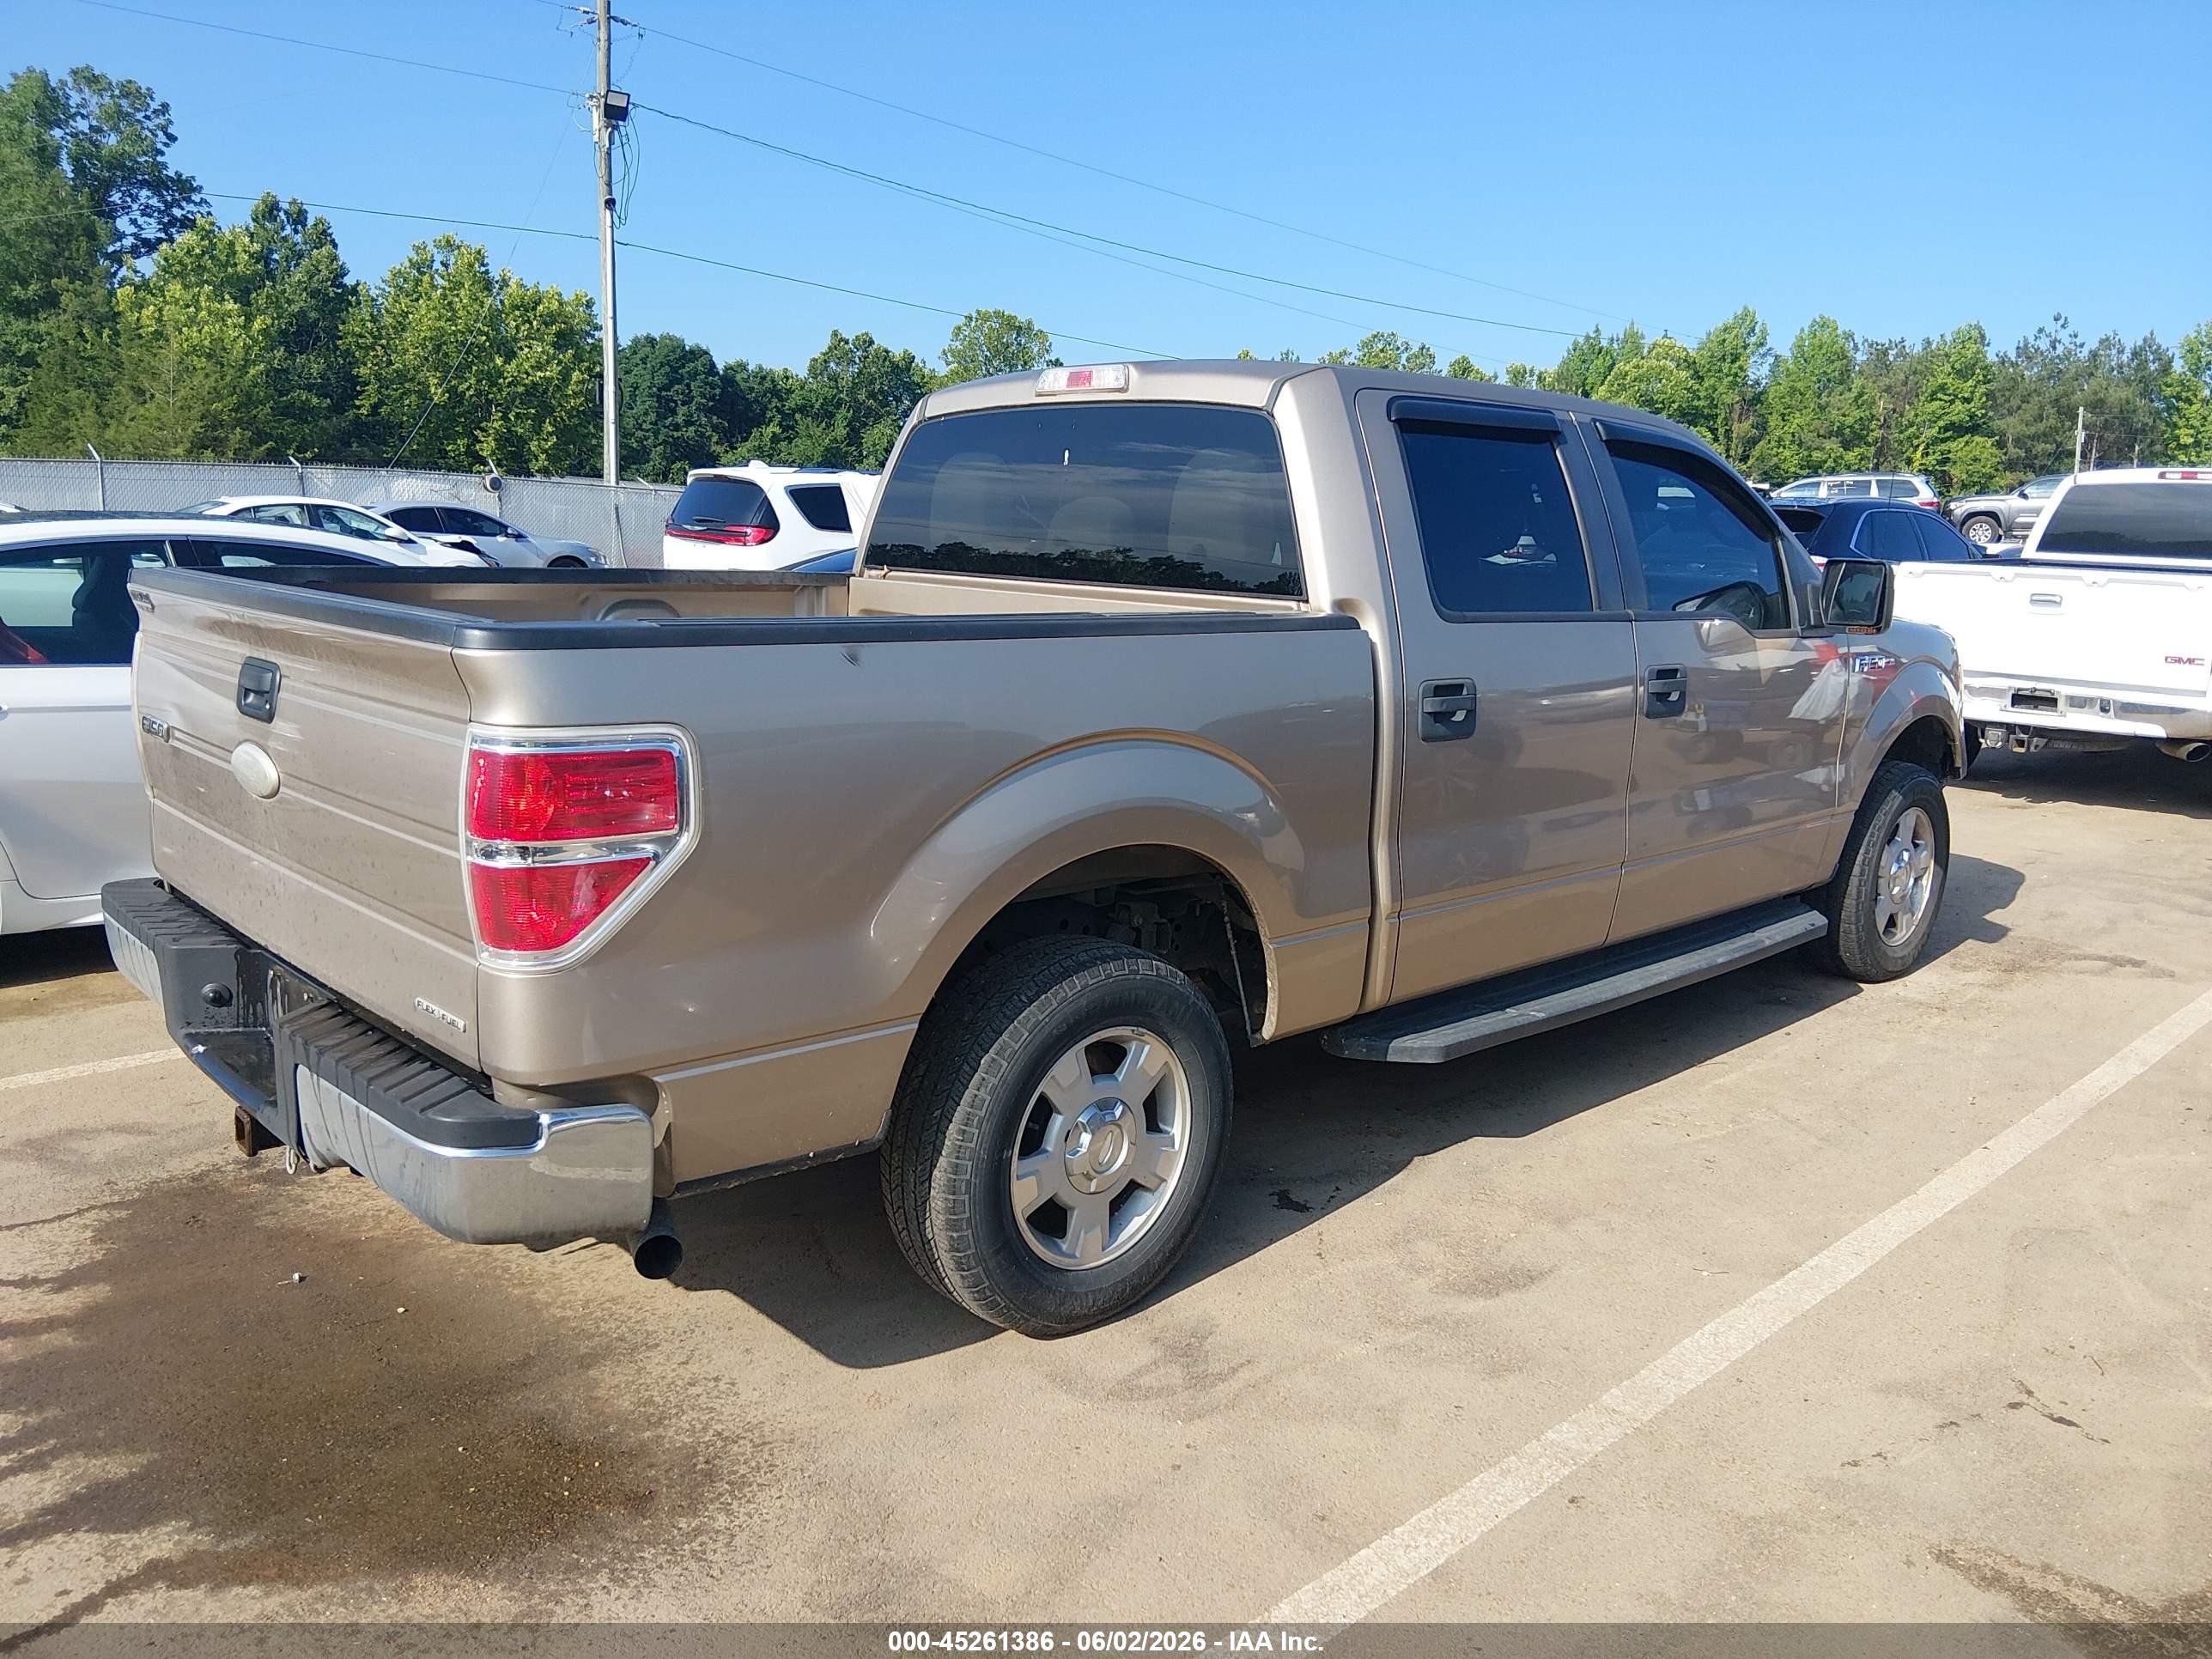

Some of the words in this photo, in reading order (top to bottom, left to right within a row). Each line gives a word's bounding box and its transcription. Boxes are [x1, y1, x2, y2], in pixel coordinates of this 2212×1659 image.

[2164, 655, 2205, 667] GMC
[416, 1000, 435, 1016] FLEX
[441, 1013, 461, 1030] FUEL
